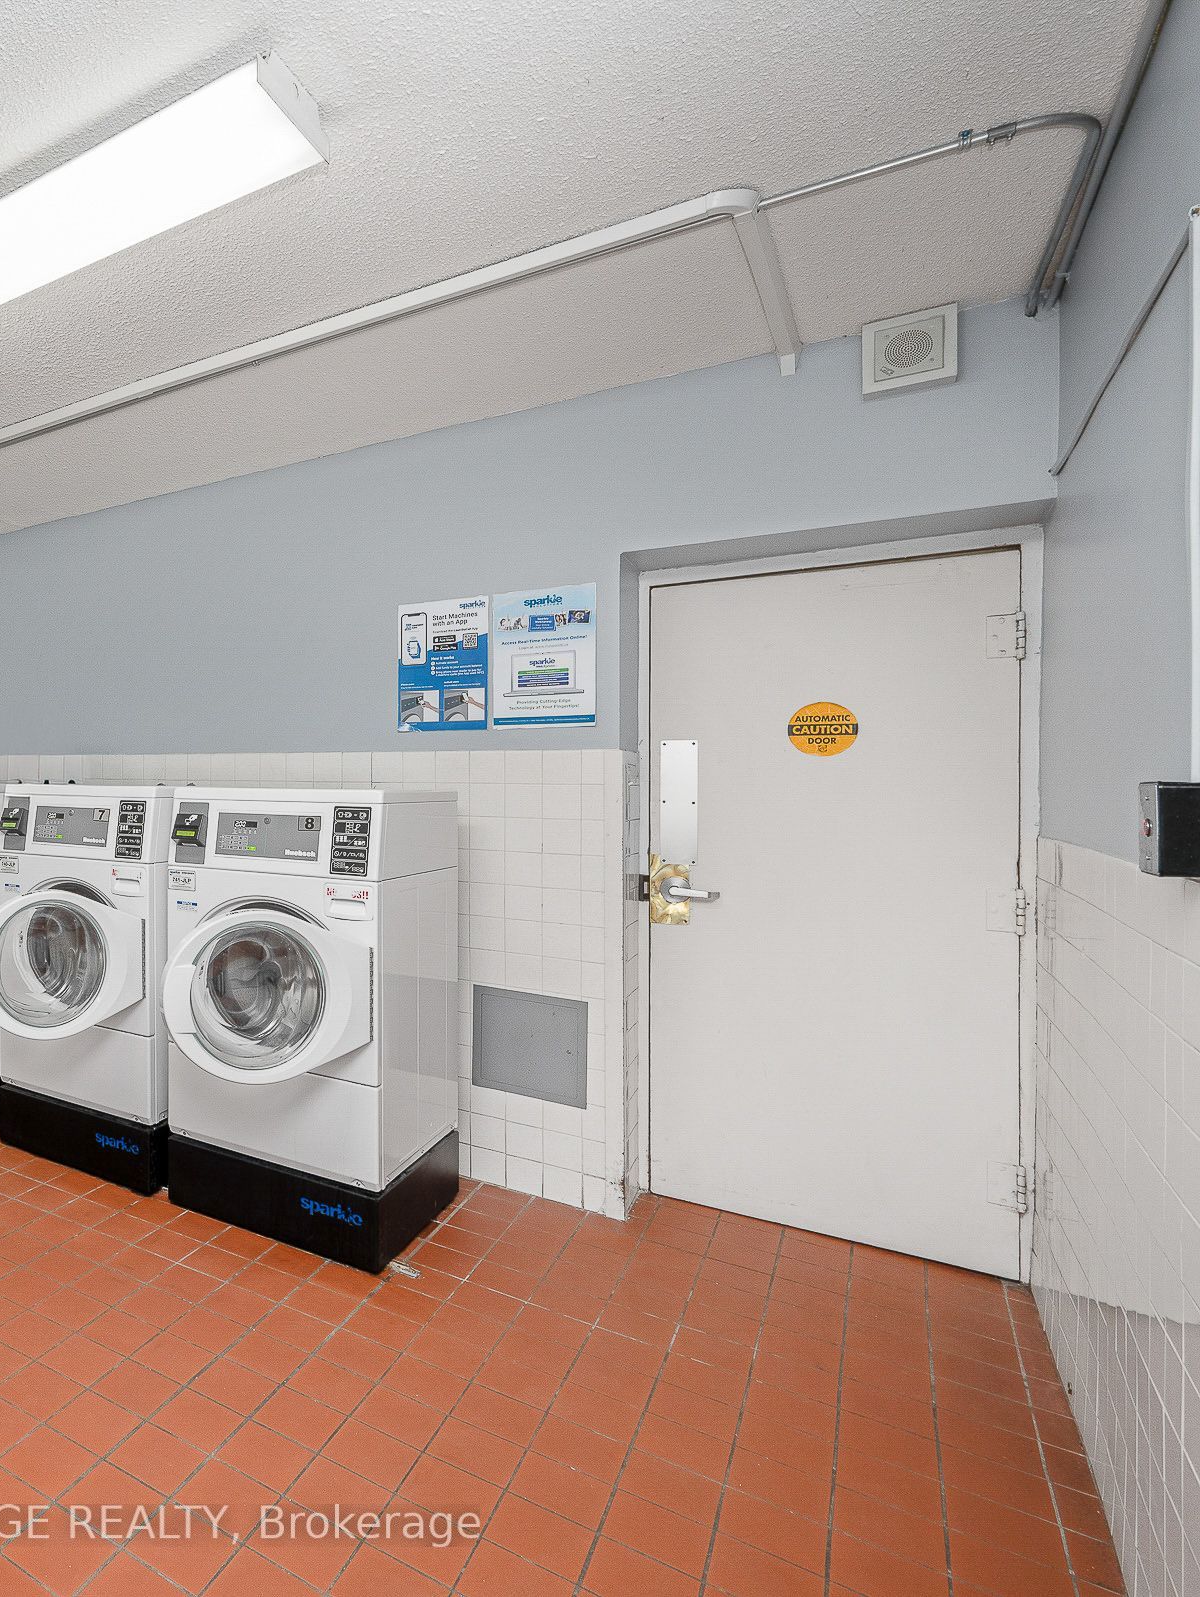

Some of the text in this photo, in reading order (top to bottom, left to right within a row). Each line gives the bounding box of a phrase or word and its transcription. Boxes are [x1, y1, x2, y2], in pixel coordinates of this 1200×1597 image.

[523, 594, 563, 608] sparkle
[448, 611, 478, 619] Machines
[794, 714, 850, 722] AUTOMATIC
[792, 724, 852, 735] CAUTION
[98, 810, 106, 820] 7
[304, 817, 314, 830] 8
[94, 1130, 141, 1156] sparkle
[300, 1196, 363, 1227] sparkle
